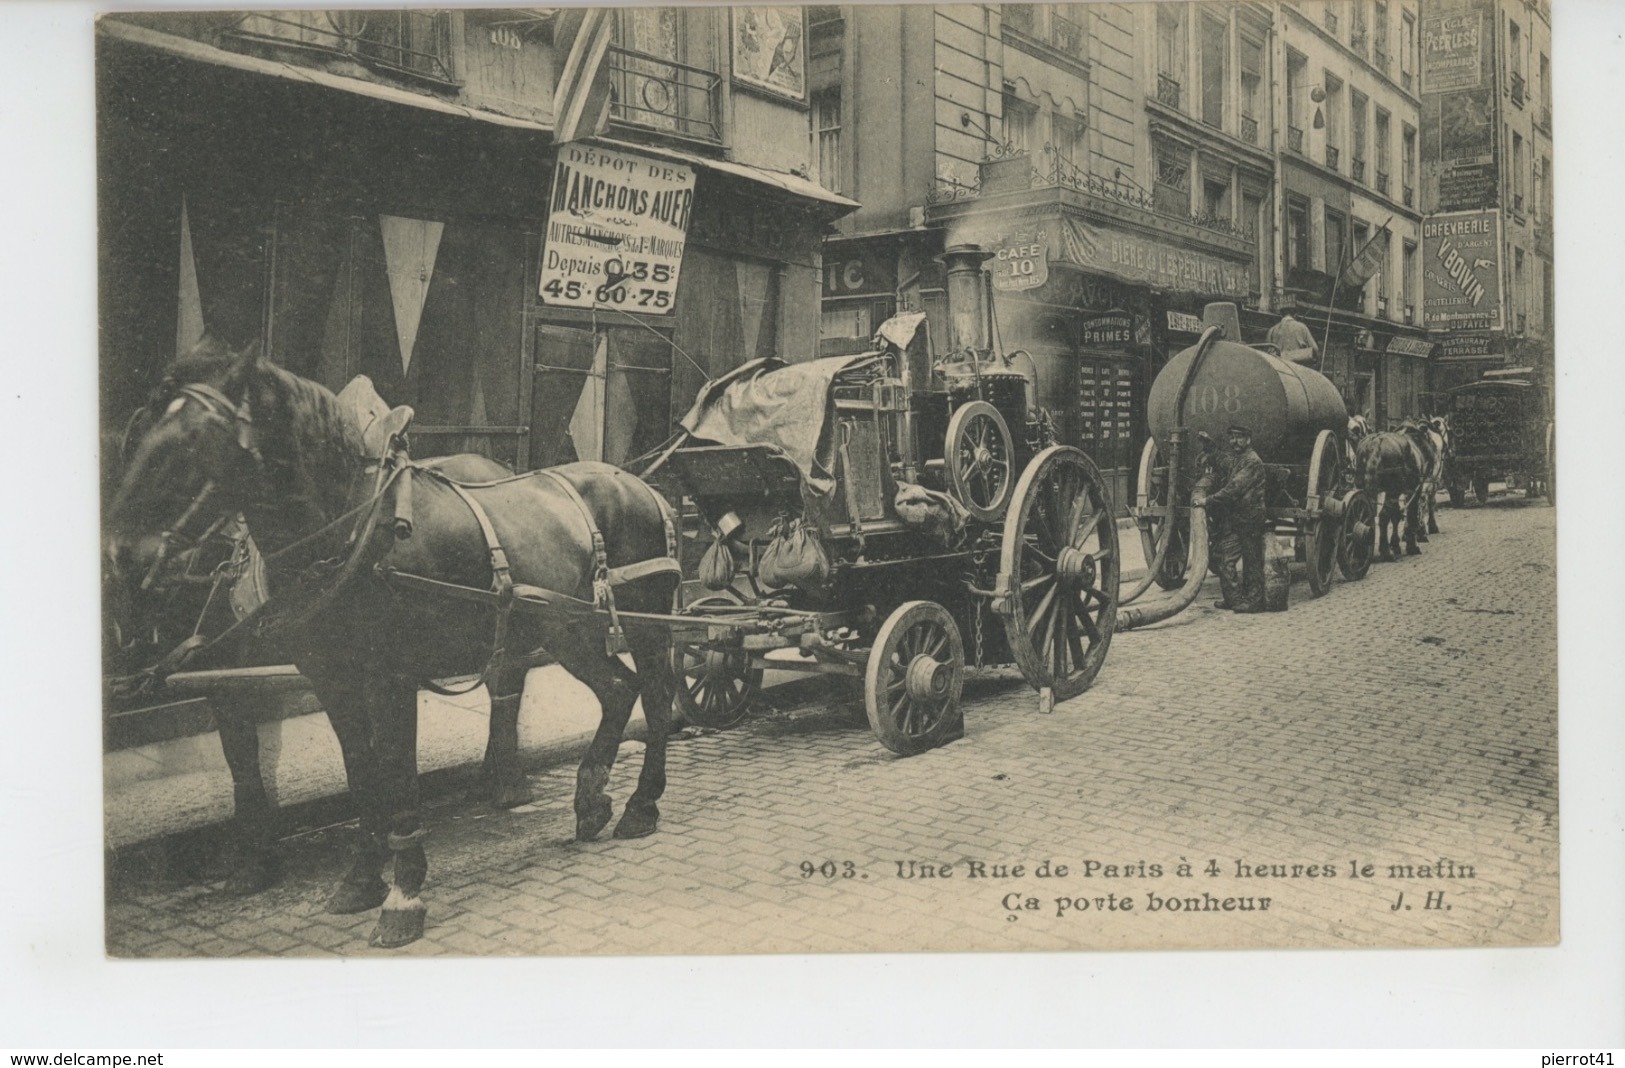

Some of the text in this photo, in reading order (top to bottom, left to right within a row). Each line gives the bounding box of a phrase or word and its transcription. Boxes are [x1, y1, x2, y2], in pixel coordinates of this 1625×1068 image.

[1426, 29, 1478, 54] PEERLESS
[648, 165, 687, 184] DES
[552, 161, 693, 234] MANCHONS AUER
[548, 221, 584, 247] AUTRES
[650, 235, 684, 261] MARQUES
[548, 250, 602, 277] Depuis
[1443, 248, 1485, 307] BOIVIN
[1083, 316, 1131, 331] CONSOMMATIONS
[1084, 330, 1130, 343] PRIMES
[1442, 337, 1490, 347] RESTAURANT
[1443, 347, 1489, 355] TERRASSE
[1190, 384, 1241, 415] 108
